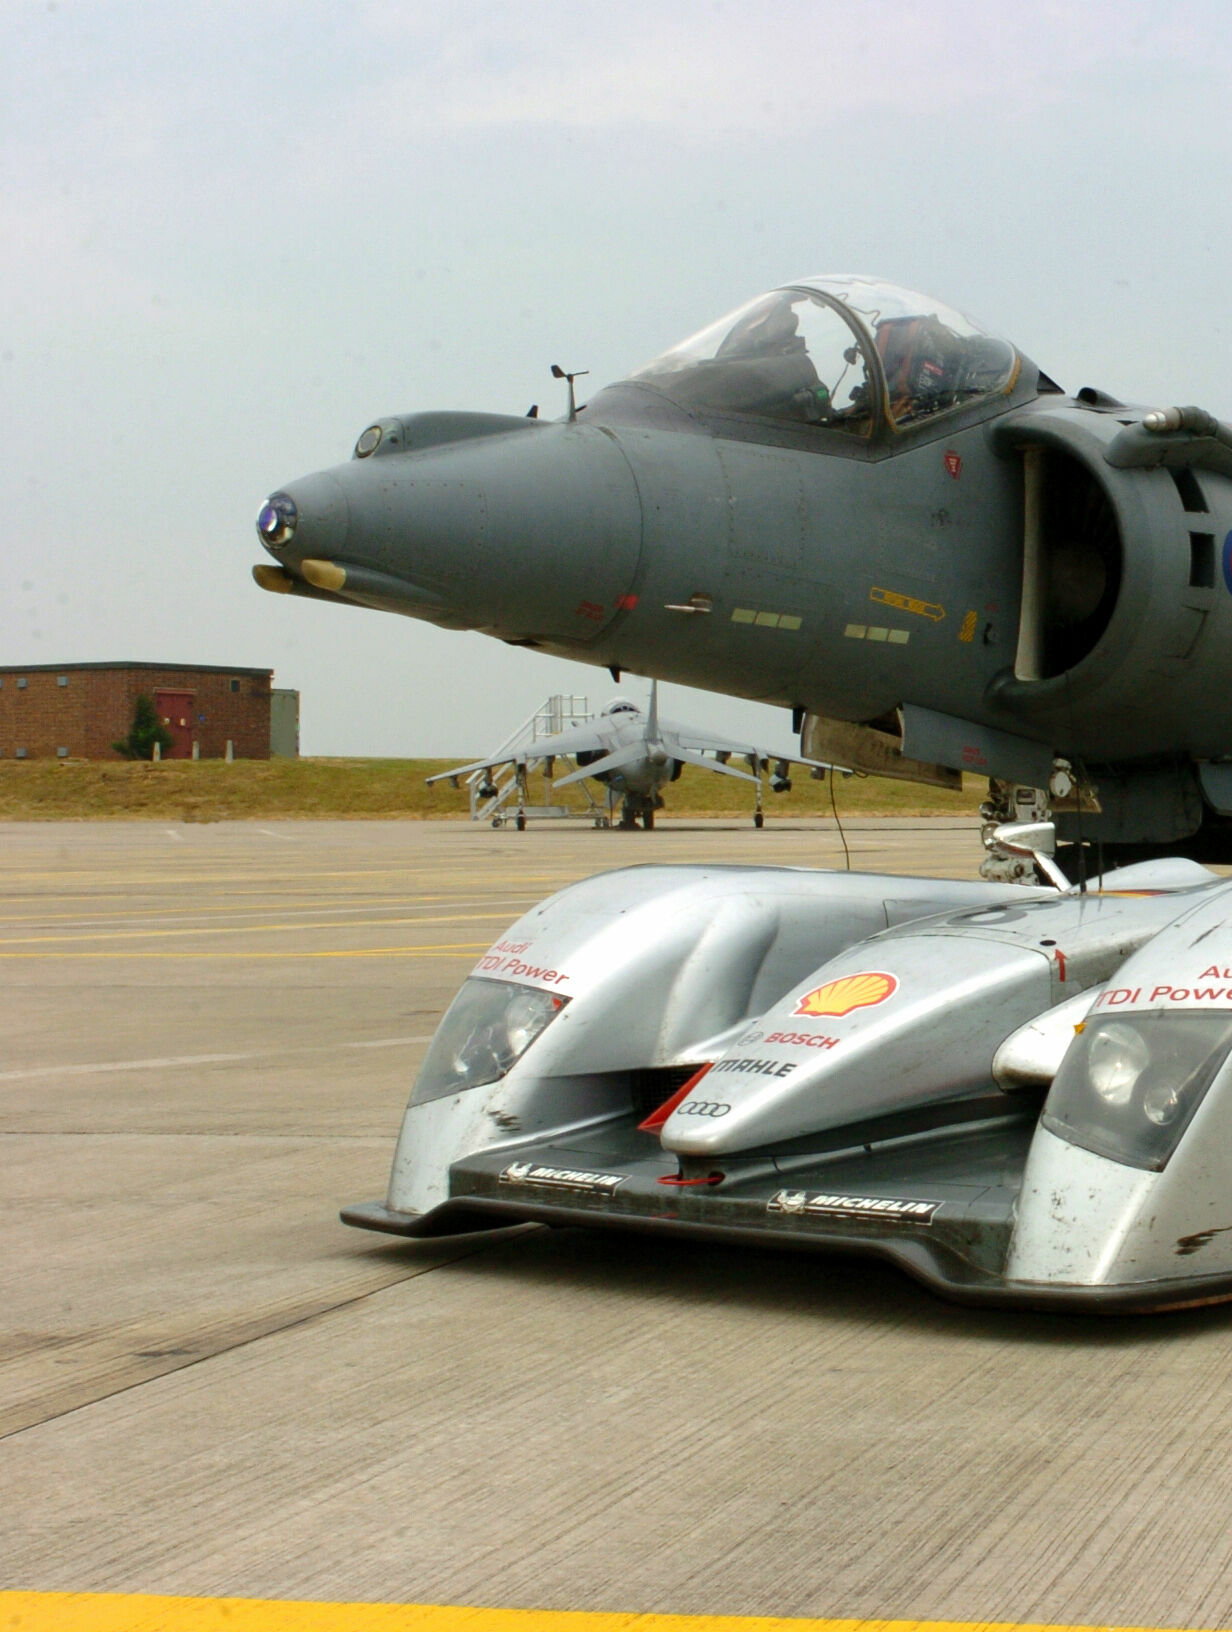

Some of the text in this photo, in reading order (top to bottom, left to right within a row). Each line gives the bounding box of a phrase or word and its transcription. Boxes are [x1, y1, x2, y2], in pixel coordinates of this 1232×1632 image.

[493, 940, 533, 955] Audi
[476, 955, 570, 985] TDI Power
[1096, 987, 1142, 1008] TDI
[763, 1032, 841, 1050] BOSCH
[711, 1059, 798, 1078] MAHLE
[527, 1167, 624, 1186] MICHELIN
[809, 1195, 936, 1214] MICHELIN
